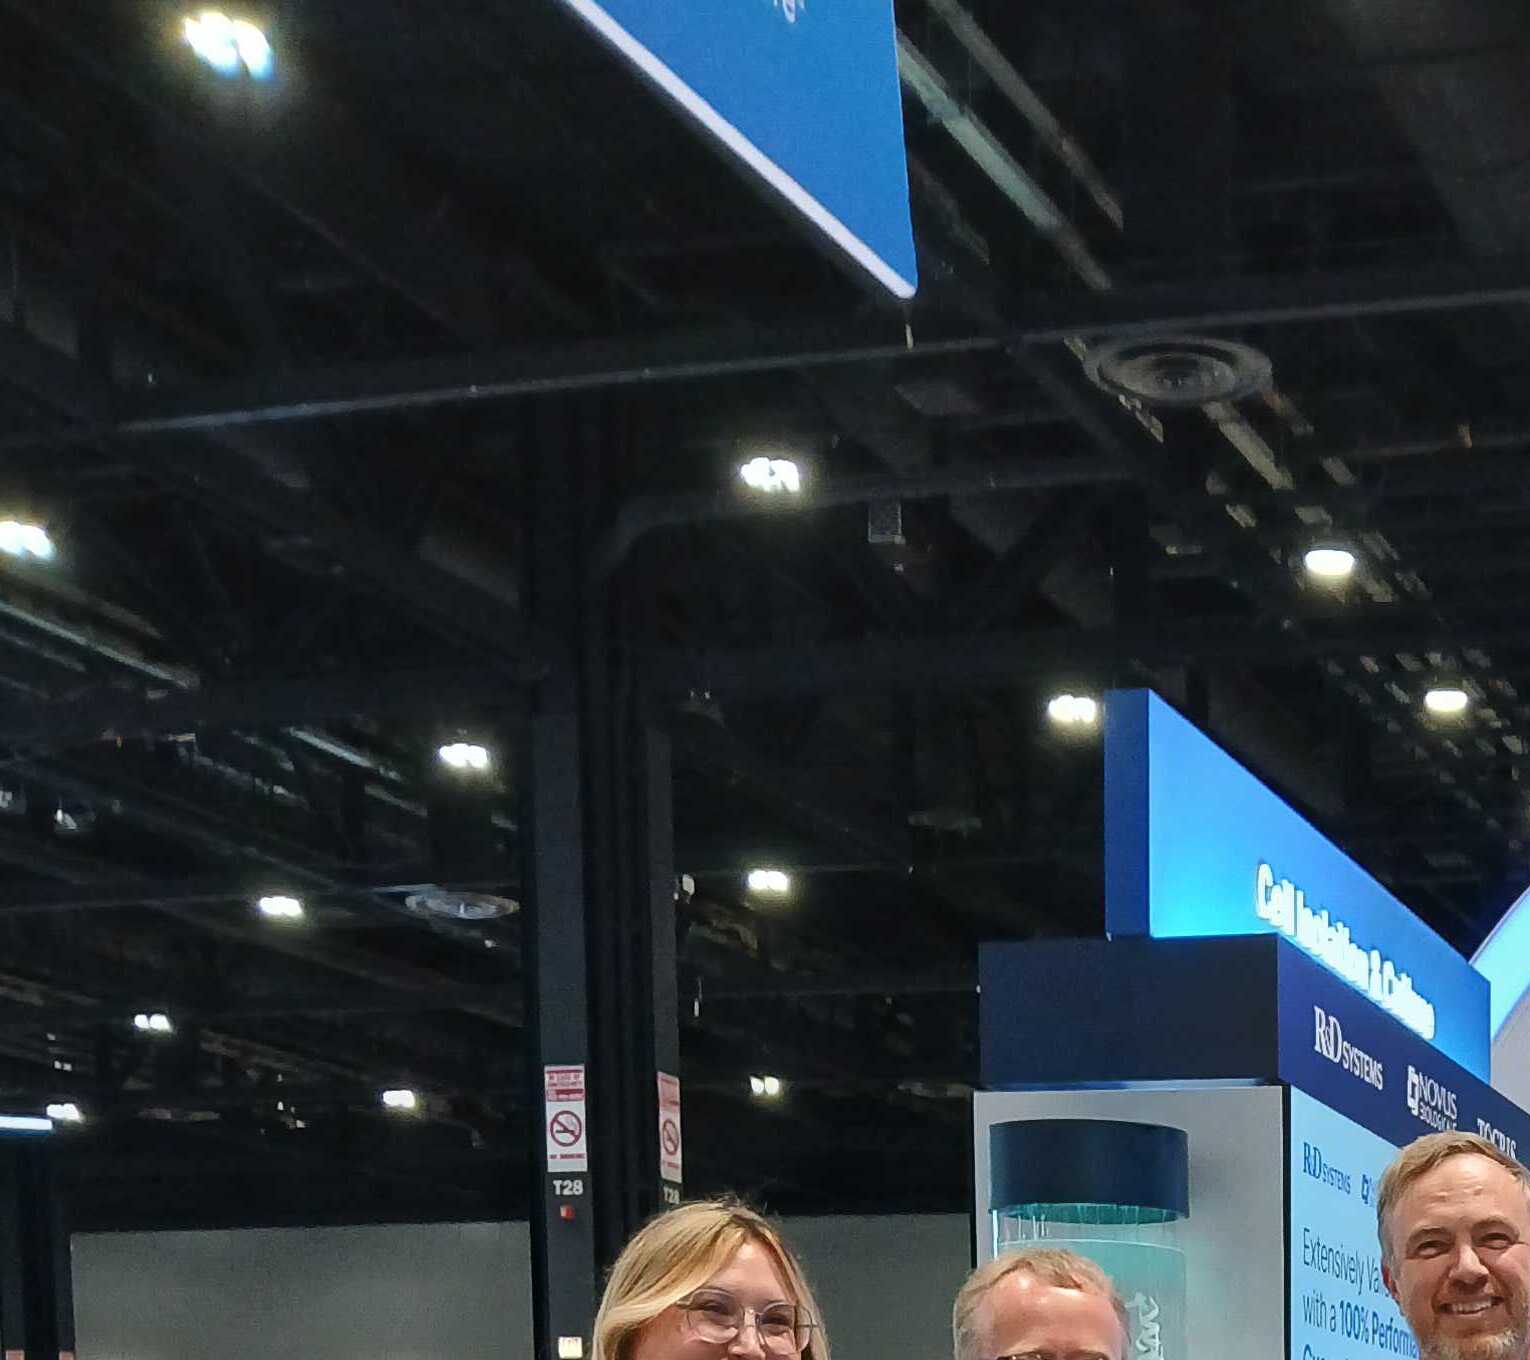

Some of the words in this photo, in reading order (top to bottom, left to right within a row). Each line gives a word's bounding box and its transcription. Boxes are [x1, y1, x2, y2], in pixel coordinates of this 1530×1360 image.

[1342, 1041, 1384, 1090] SYSTEMS
[1419, 1071, 1457, 1120] NOVUS
[552, 1179, 584, 1196] T28
[1303, 1227, 1365, 1296] Extensively
[1303, 1290, 1327, 1329] with
[1329, 1304, 1337, 1333] a
[1340, 1300, 1369, 1345] 100%
